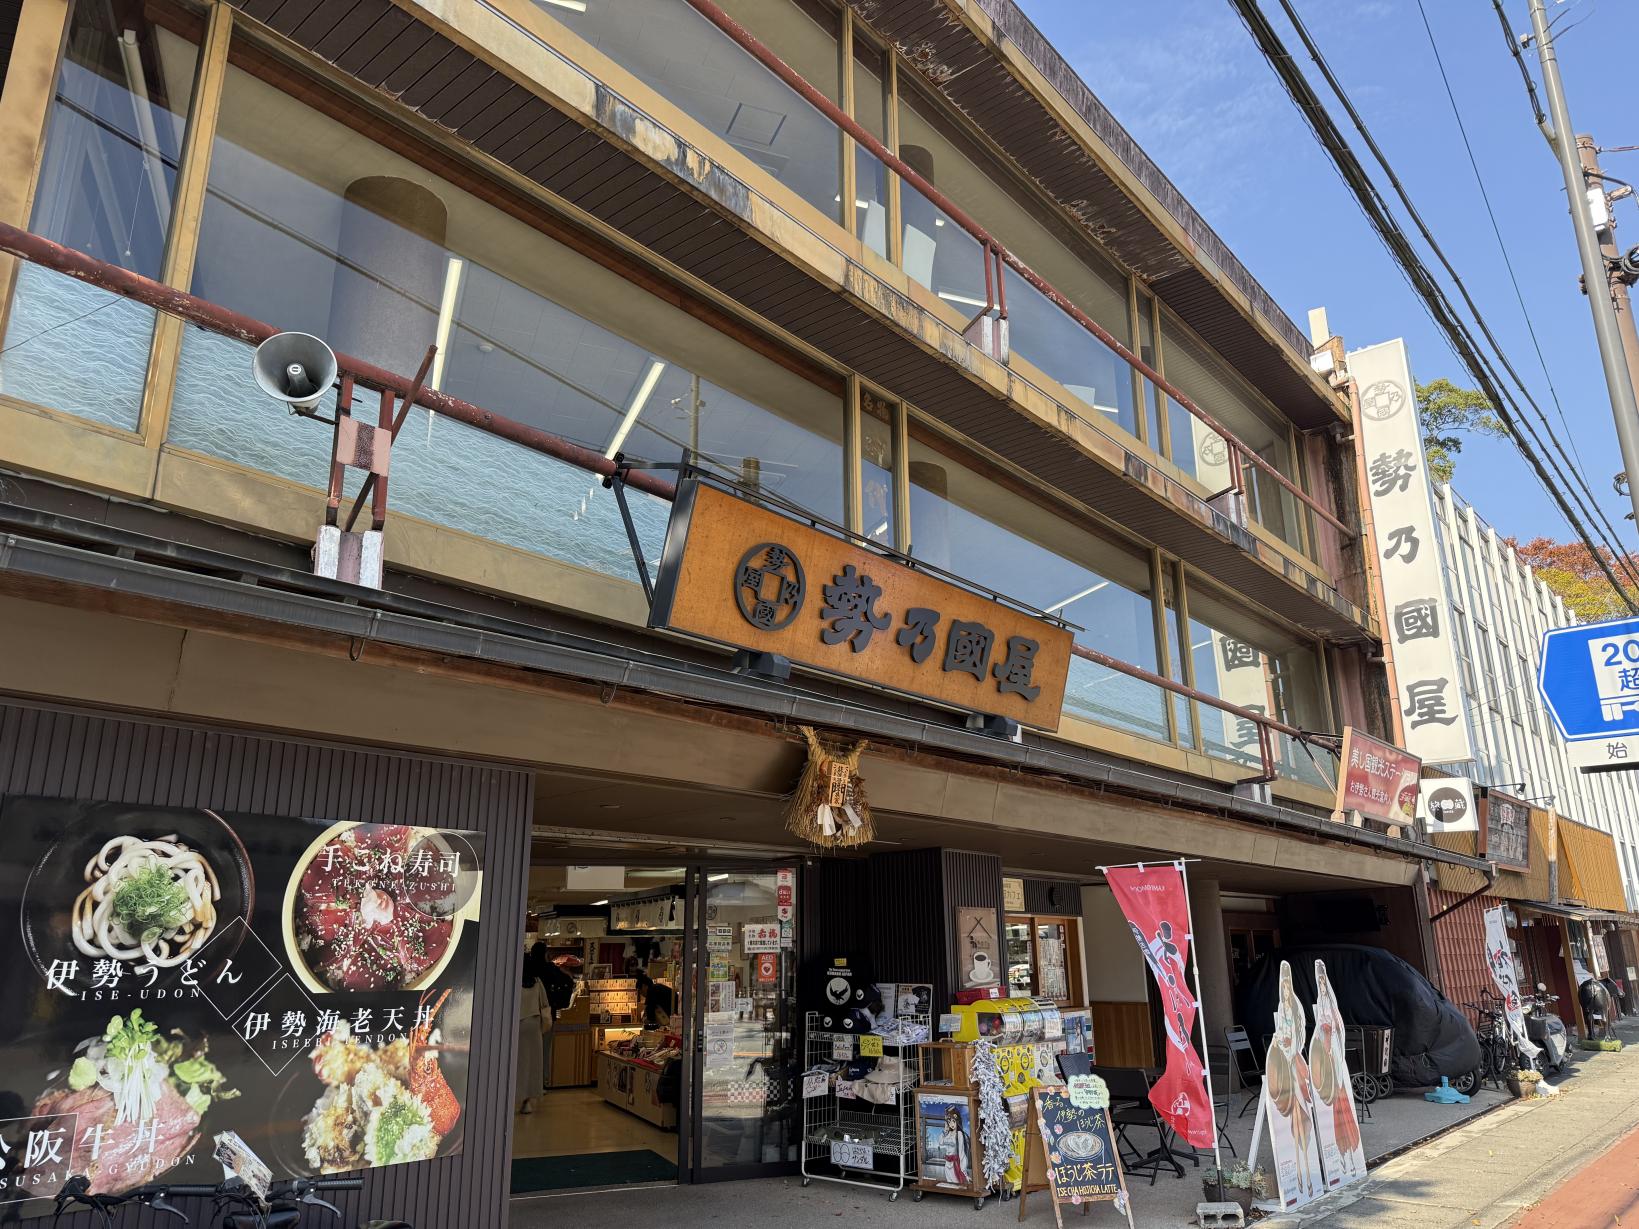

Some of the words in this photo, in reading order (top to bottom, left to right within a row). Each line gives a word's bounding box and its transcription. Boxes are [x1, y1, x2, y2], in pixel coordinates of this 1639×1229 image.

[1369, 448, 1459, 731] 勢乃國屋
[820, 564, 1041, 702] 勢乃國屋
[1618, 667, 1639, 692] 超
[1606, 742, 1628, 759] 始
[317, 844, 461, 878] 手こね寿司
[47, 958, 243, 990] 伊勢うどん
[81, 988, 201, 1000] ISE-UDON
[243, 1005, 434, 1040] 伊勢海老天丼
[1055, 1162, 1115, 1184] ほうじ茶ラテ
